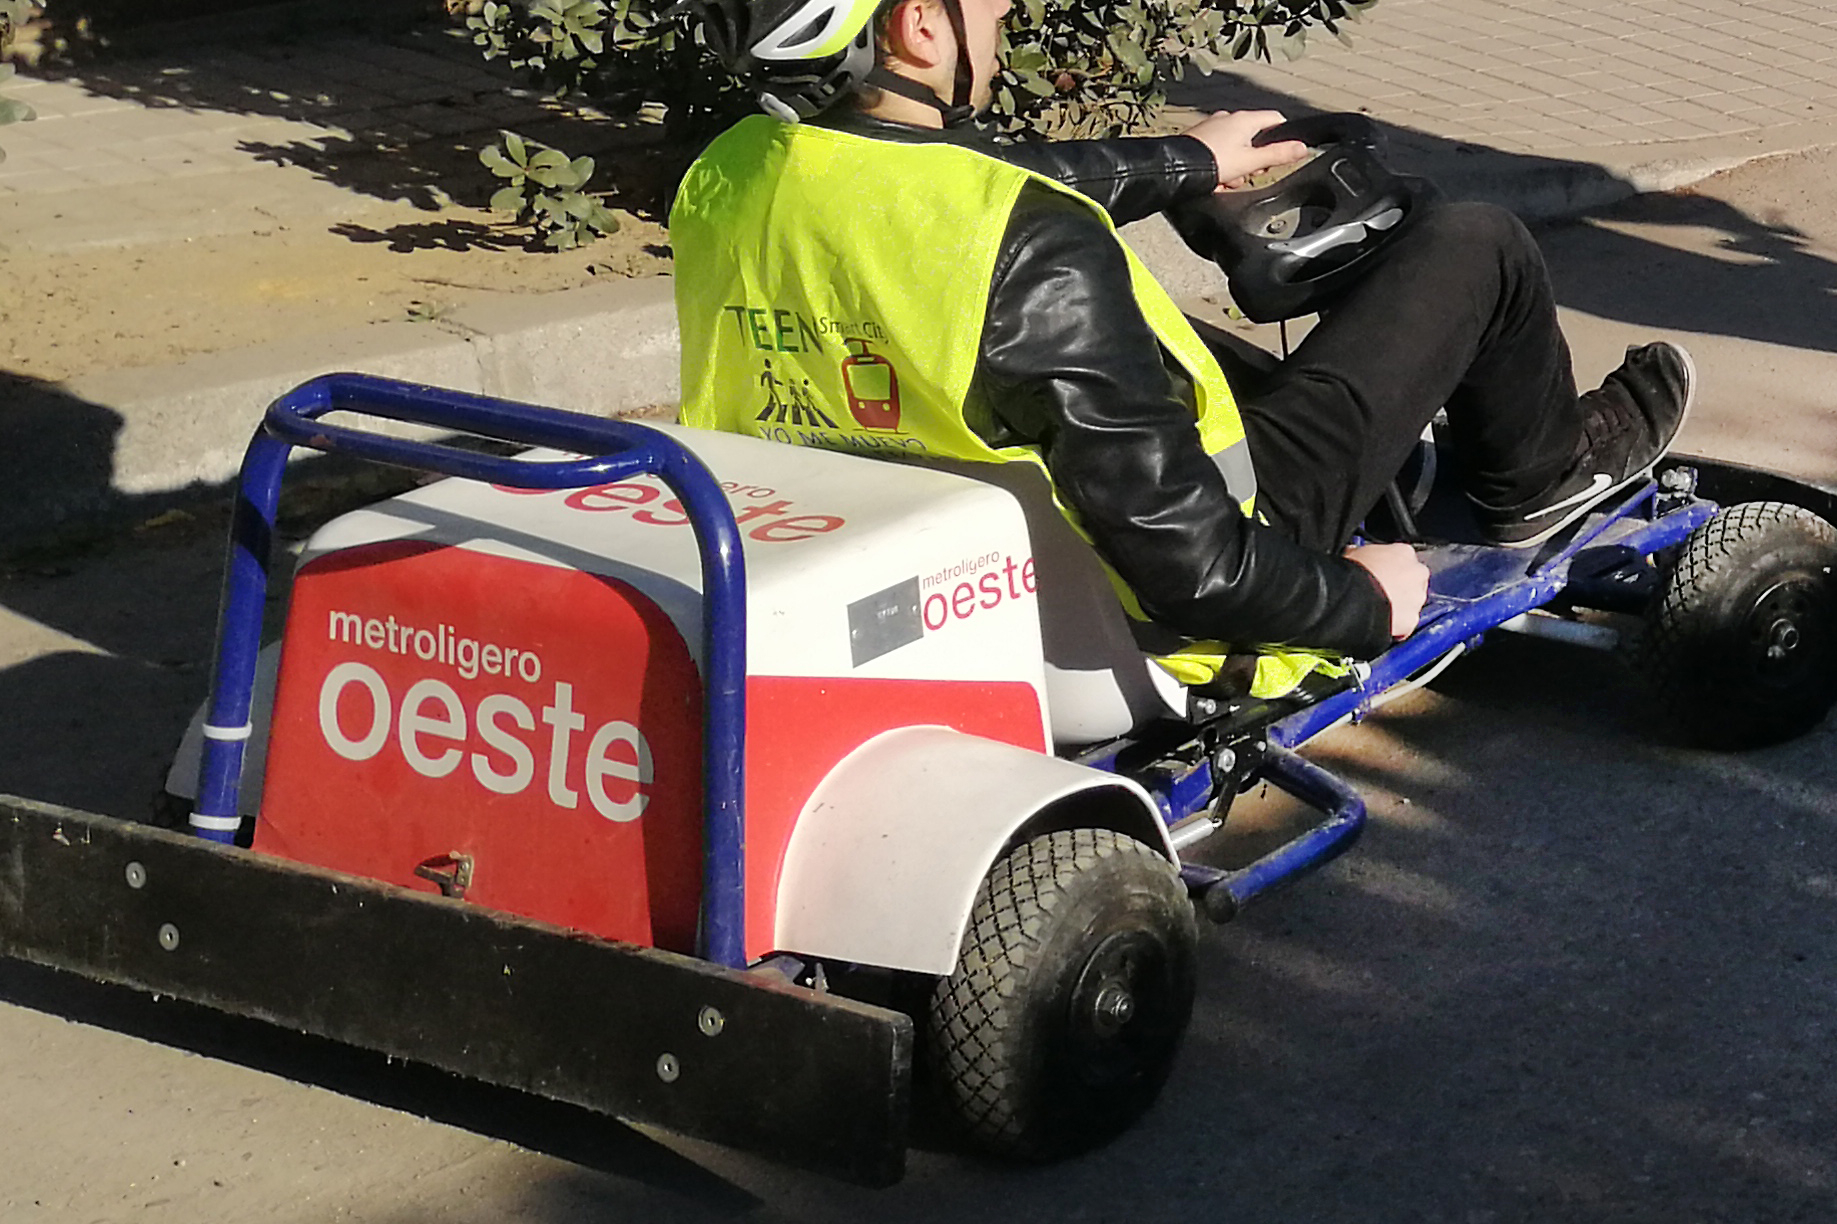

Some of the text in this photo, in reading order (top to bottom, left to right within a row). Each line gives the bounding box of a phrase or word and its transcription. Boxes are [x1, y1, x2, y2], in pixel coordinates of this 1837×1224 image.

[724, 306, 824, 356] TEEN
[760, 426, 791, 445] YO
[796, 430, 838, 446] ME
[922, 551, 1000, 590] metroligero
[923, 555, 1038, 631] oeste
[328, 608, 542, 682] metroligero
[318, 660, 655, 823] oeste
